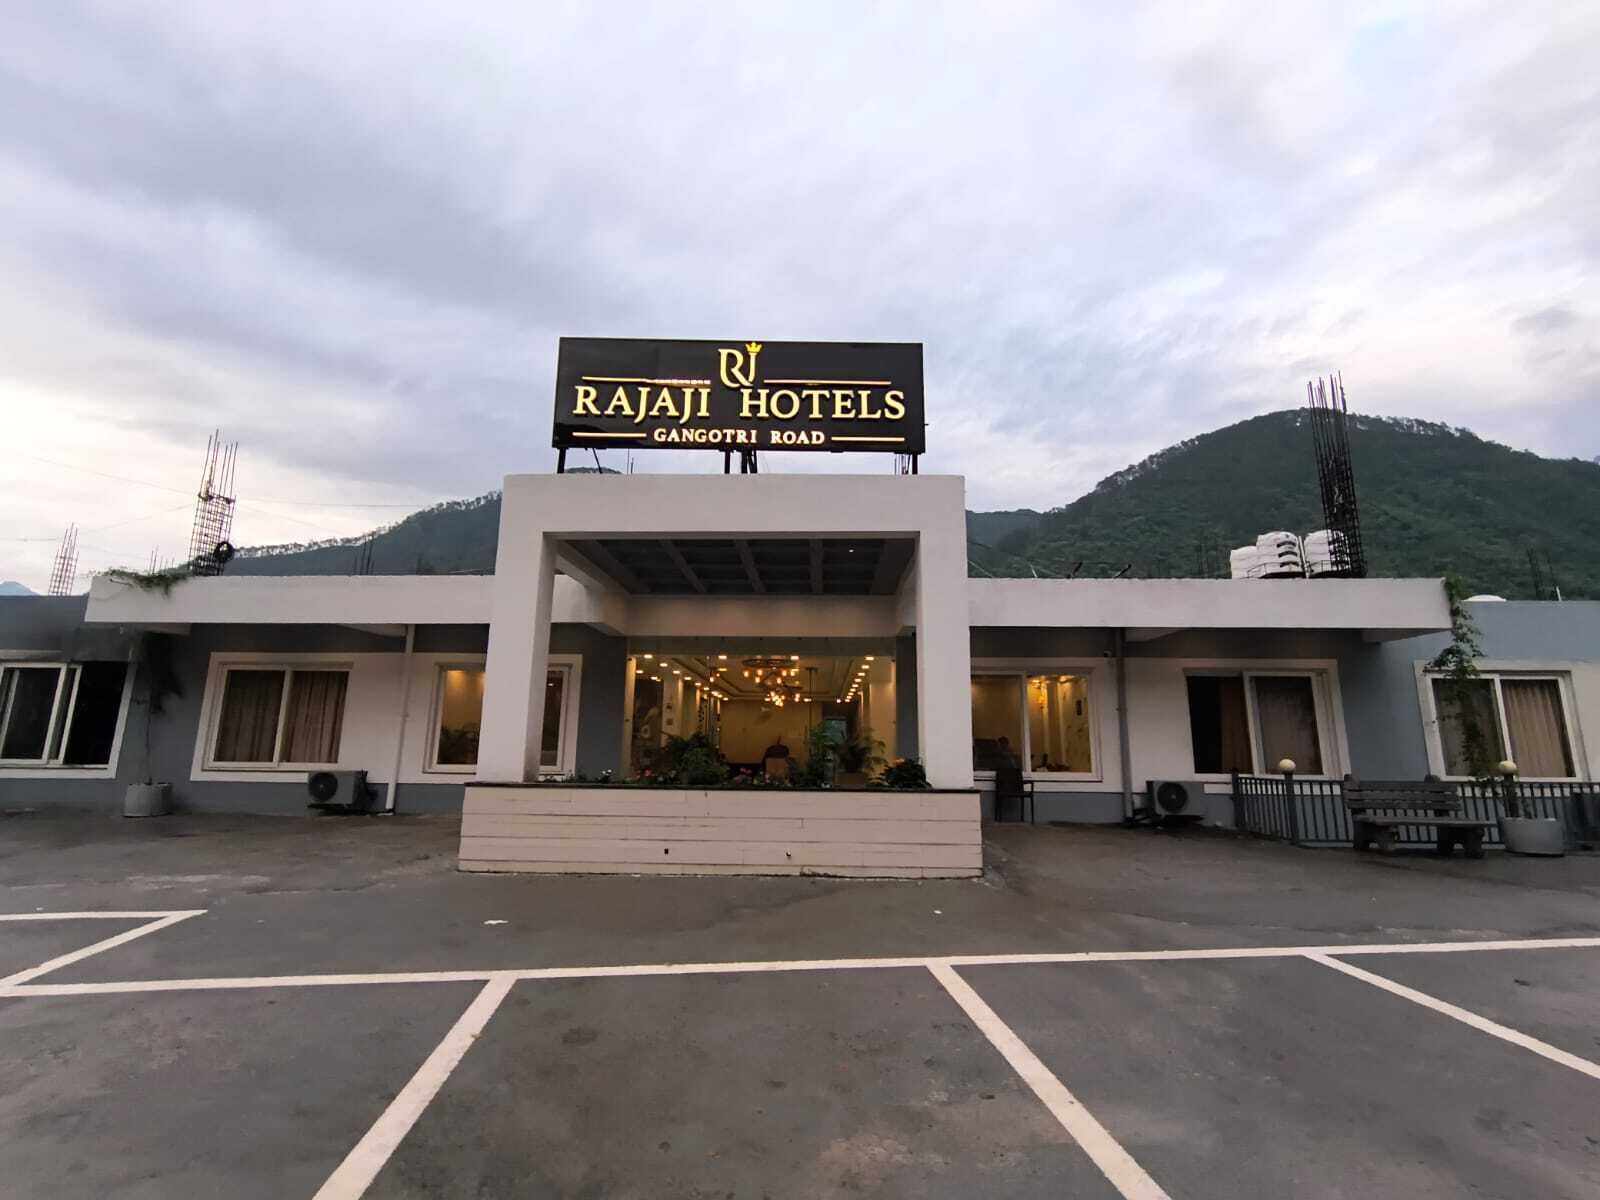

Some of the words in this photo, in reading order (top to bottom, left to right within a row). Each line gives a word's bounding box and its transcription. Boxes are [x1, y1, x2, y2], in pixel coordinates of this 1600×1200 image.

[572, 385, 711, 424] RAJAJI
[740, 388, 906, 420] HOTELS
[653, 428, 757, 444] GANGOTRI
[770, 430, 826, 445] ROAD
